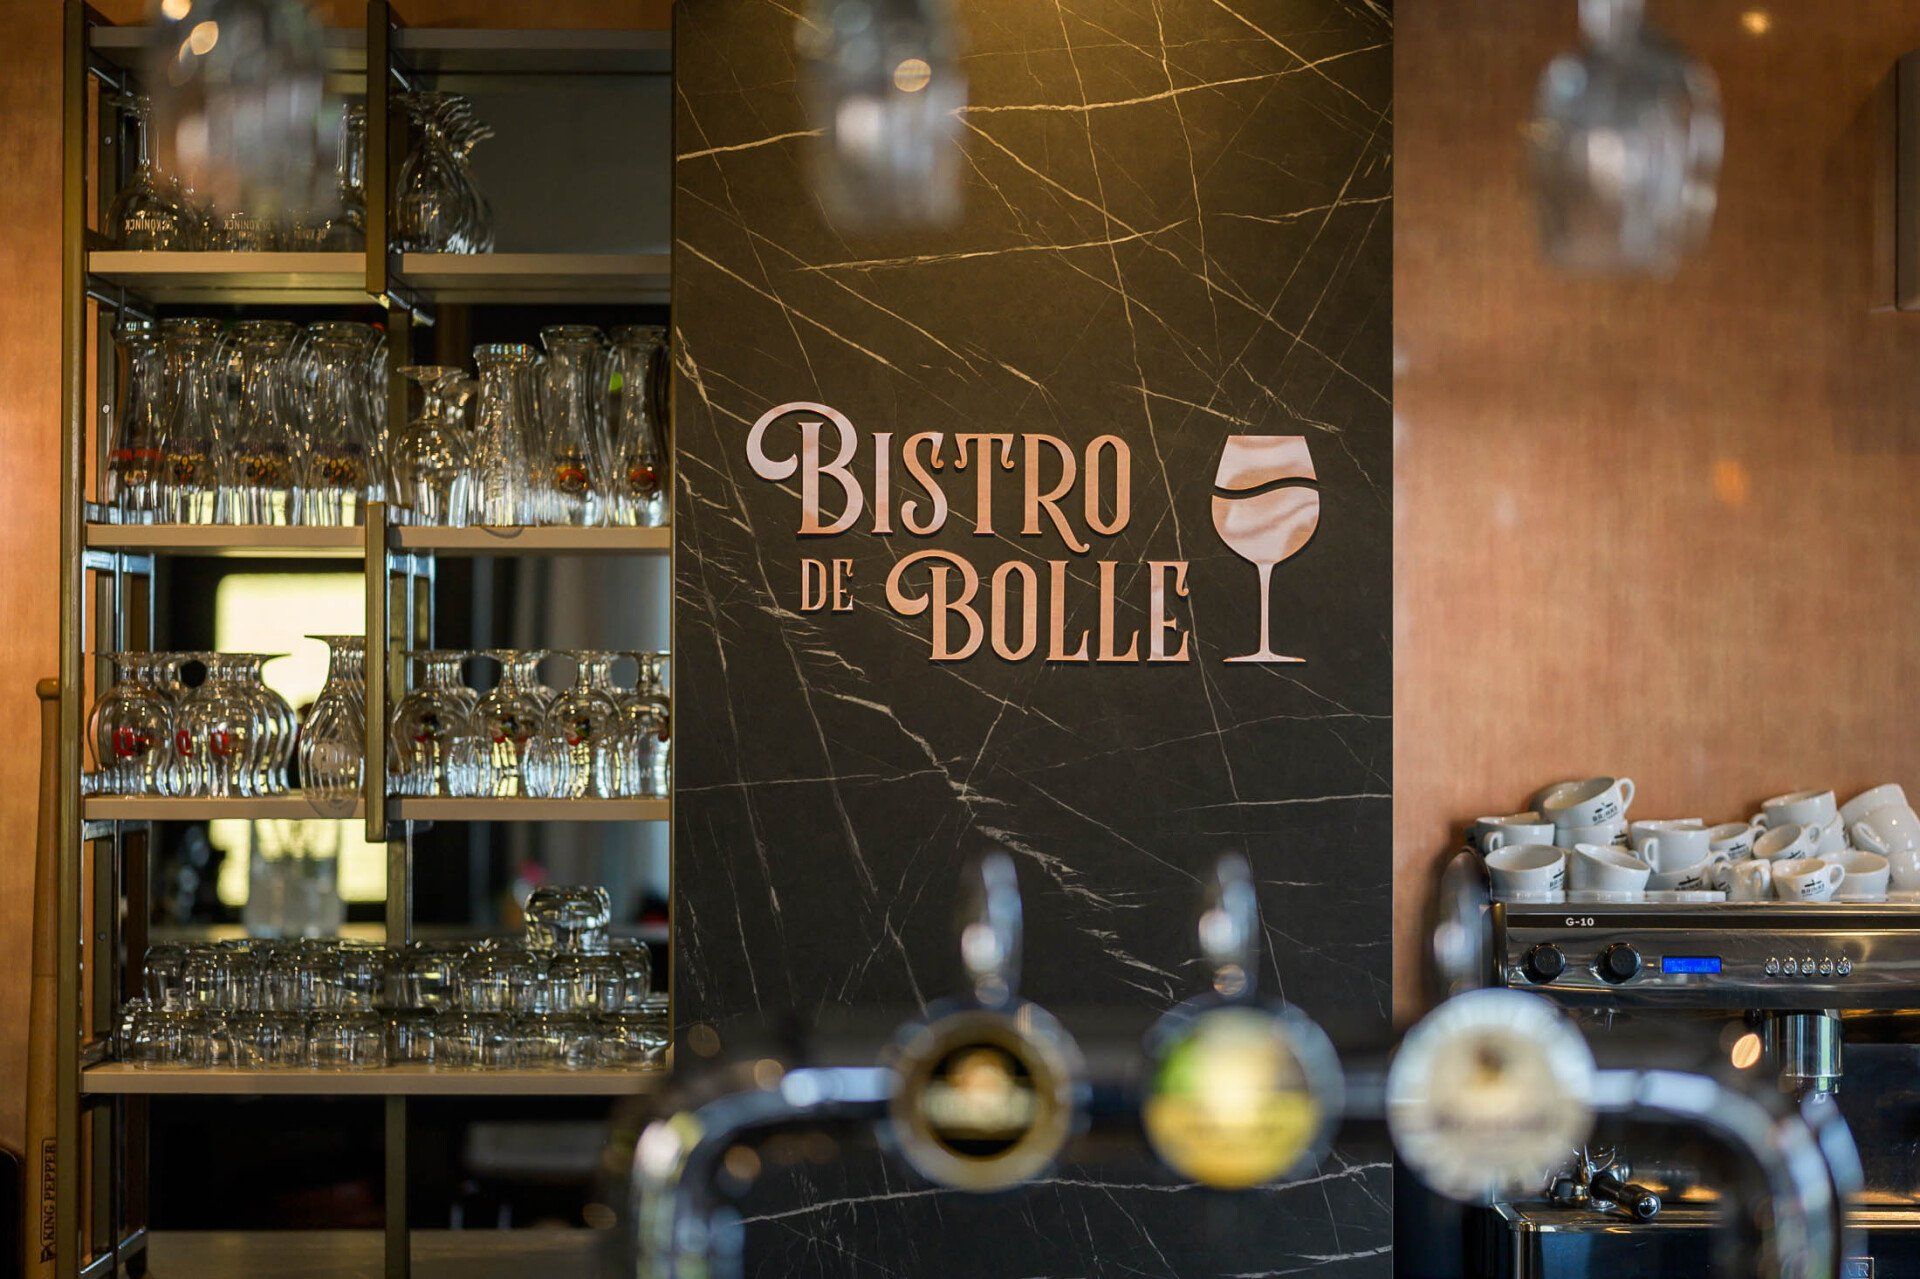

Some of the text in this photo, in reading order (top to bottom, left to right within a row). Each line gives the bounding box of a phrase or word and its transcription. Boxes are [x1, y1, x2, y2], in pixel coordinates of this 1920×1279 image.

[124, 219, 162, 231] KONINCK
[746, 402, 1131, 553] BISTRO
[800, 549, 1190, 662] DE BOLLE
[1565, 917, 1594, 927] G-10
[43, 1144, 56, 1241] KING PEPPER
